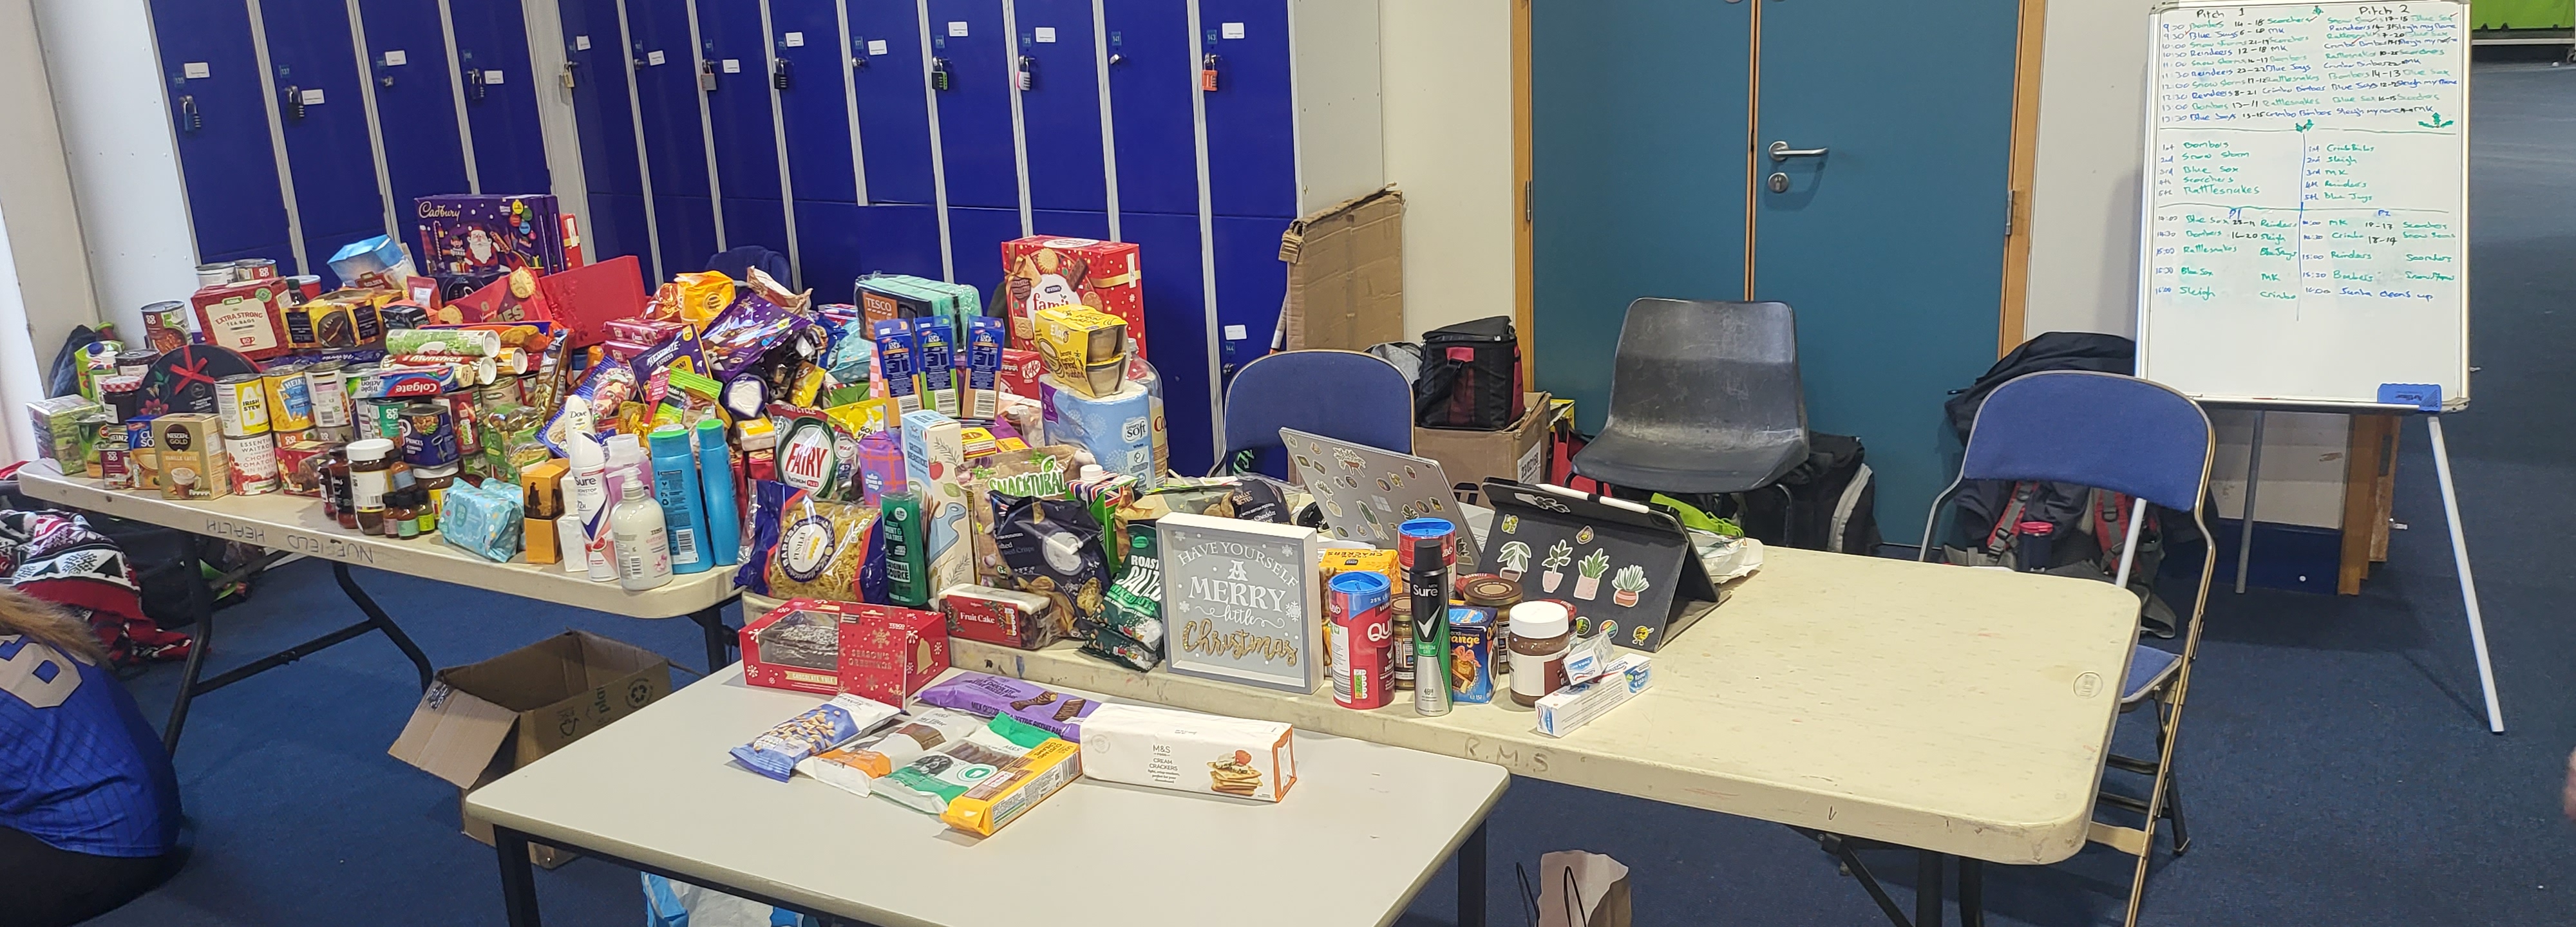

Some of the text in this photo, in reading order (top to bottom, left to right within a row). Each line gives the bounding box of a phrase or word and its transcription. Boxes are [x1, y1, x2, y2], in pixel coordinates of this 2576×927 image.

[2197, 9, 2224, 21] Pitch
[2358, 4, 2410, 15] Pitch 2
[2183, 165, 2211, 174] Blue
[2306, 167, 2321, 176] 3rd
[2183, 183, 2260, 196] Rattlesnakes
[419, 201, 462, 223] Cadbury
[2209, 216, 2230, 225] Sox
[2260, 272, 2281, 282] MK
[2179, 286, 2216, 301] Sleigh
[2416, 294, 2434, 303] up
[865, 297, 892, 312] TESCO
[215, 312, 263, 325] EXTRA STRONG
[410, 354, 463, 363] Munchies
[395, 382, 438, 395] Colgate
[570, 410, 587, 419] Dove
[1126, 420, 1146, 438] soft
[784, 442, 829, 479] FAIRY
[575, 477, 597, 490] Sure
[807, 480, 820, 488] PLUS
[989, 473, 1066, 496] SNACKTURAL
[207, 519, 265, 543] HEALTH
[781, 524, 800, 568] BARESA
[793, 531, 806, 561] FUSILLI
[1327, 551, 1383, 560] CRACKERS
[1177, 541, 1299, 588] HAVE YOURSELF
[1227, 559, 1249, 581] A
[1188, 576, 1286, 613] MERRY
[1412, 585, 1438, 597] Sure
[1370, 597, 1381, 606] 25%
[960, 612, 996, 624] Fruit Cake
[1182, 618, 1298, 667] Christmas
[1450, 635, 1481, 649] ange
[851, 649, 890, 660] SEASON'S
[848, 659, 893, 670] GREETINGS
[792, 673, 820, 682] CHOCOLATE
[1152, 744, 1171, 754] M&S
[1148, 763, 1178, 772] CRACKERS
